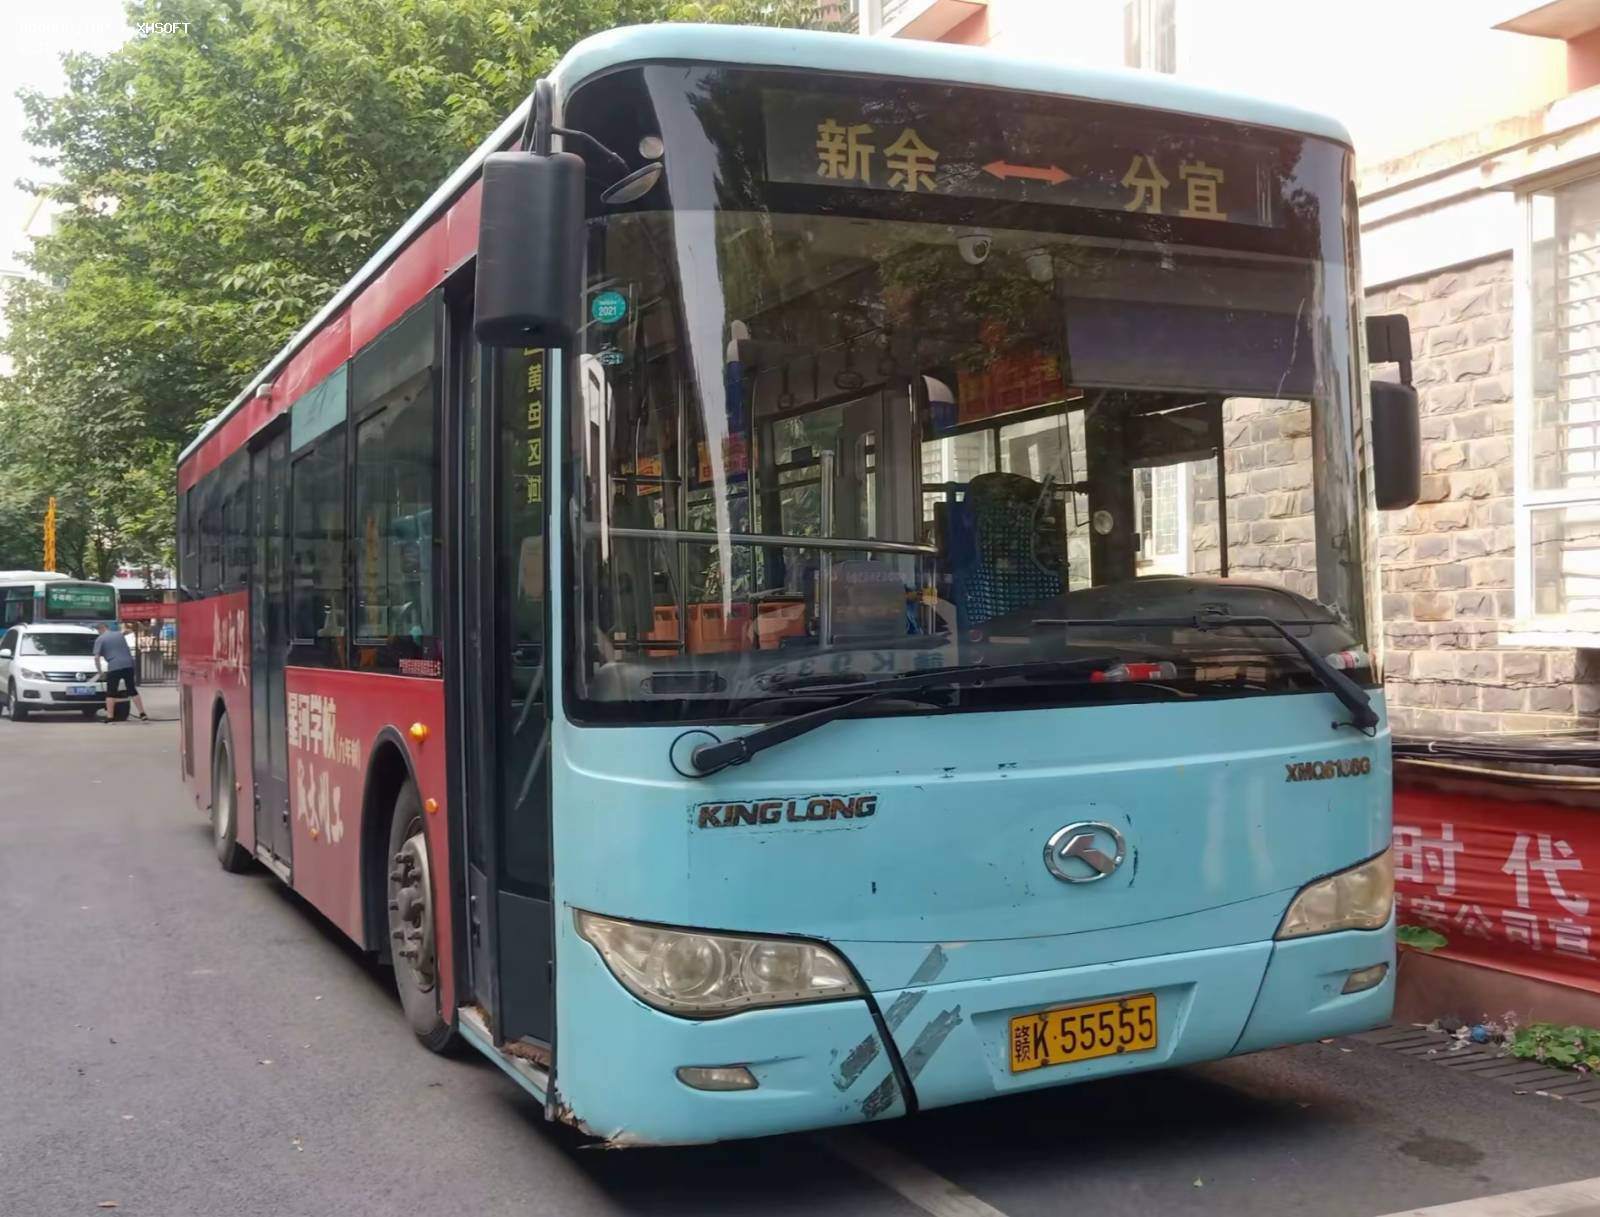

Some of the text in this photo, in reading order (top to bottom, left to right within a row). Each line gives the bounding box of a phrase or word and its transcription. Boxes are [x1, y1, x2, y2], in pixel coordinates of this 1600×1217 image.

[815, 118, 1228, 222] 新余 分宜
[698, 795, 878, 829] KING LONG
[1393, 823, 1590, 917] 时代
